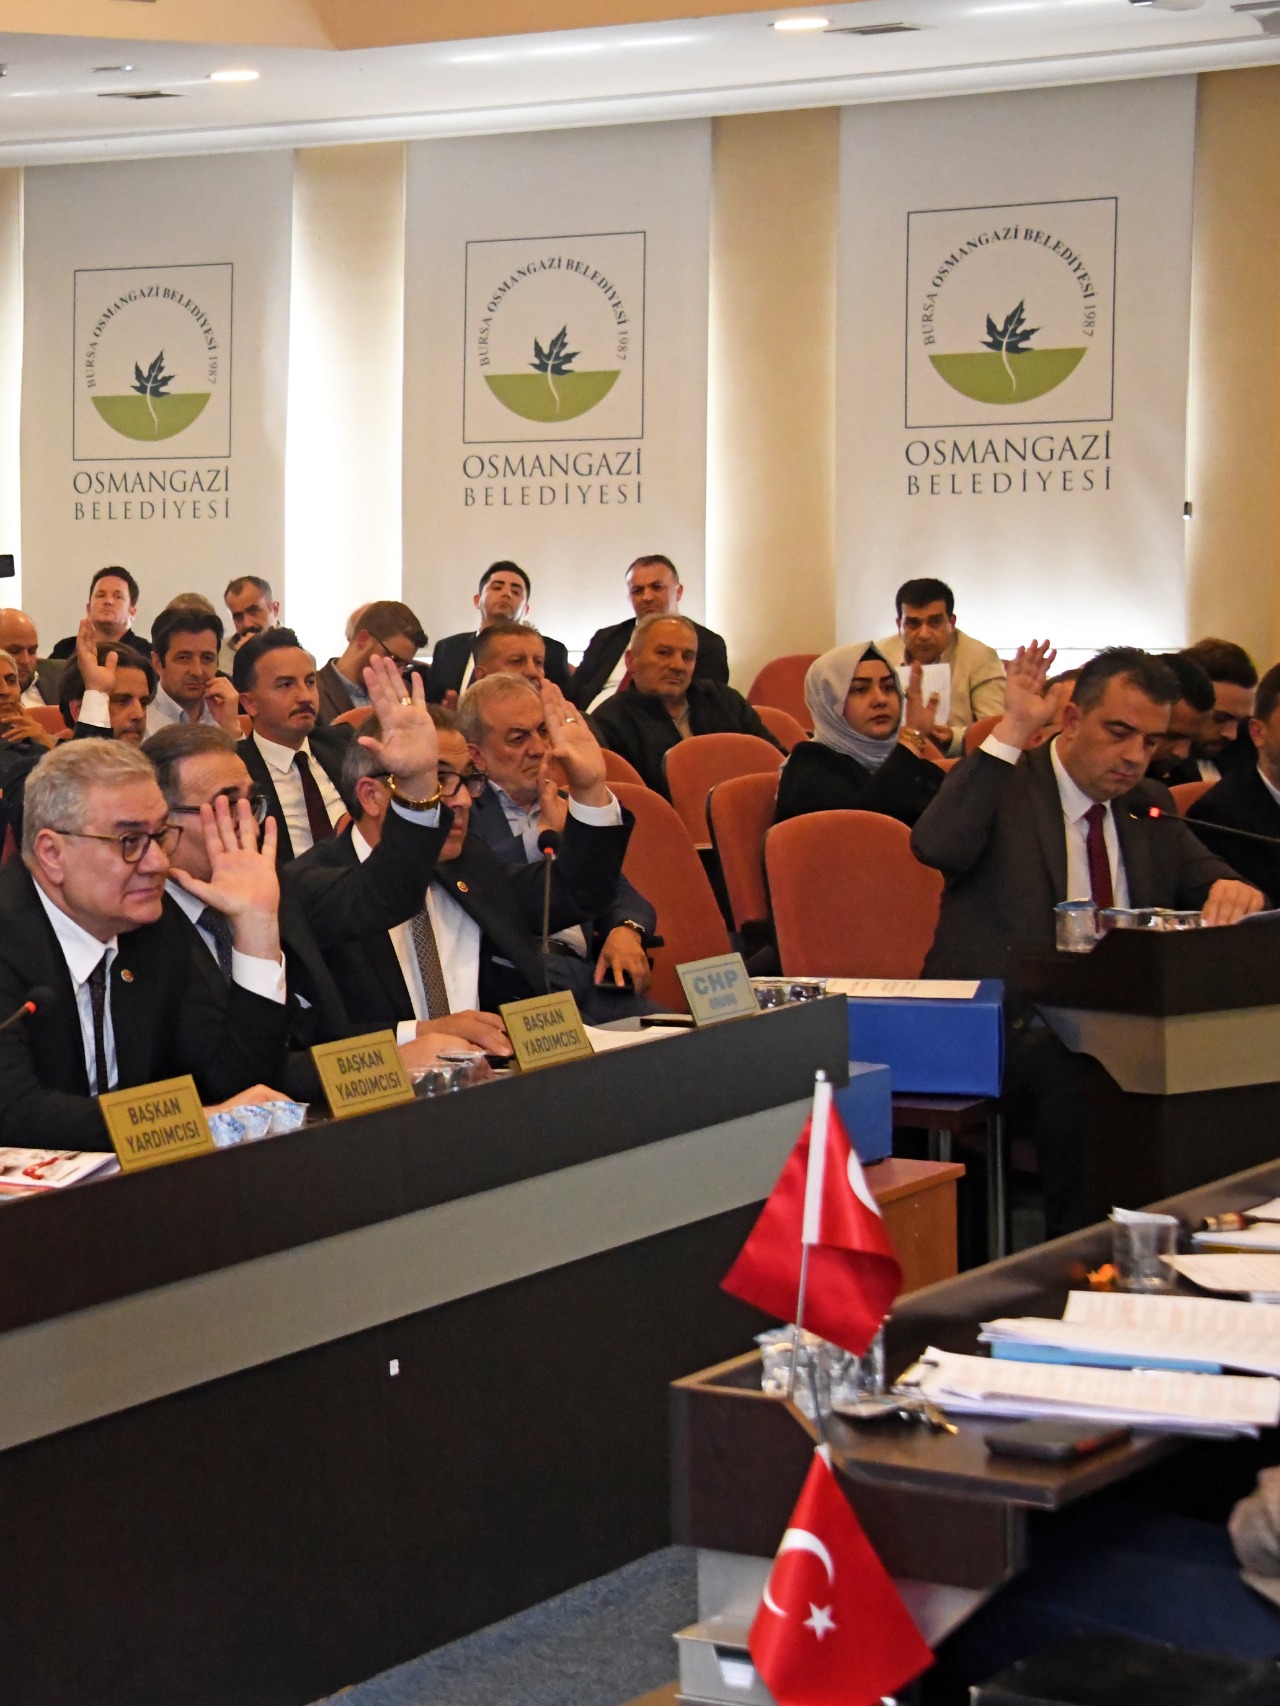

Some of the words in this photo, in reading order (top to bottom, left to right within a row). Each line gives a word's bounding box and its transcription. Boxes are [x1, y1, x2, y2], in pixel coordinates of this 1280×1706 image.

[922, 292, 938, 346] BURSA
[932, 224, 1020, 289] OSMANGAZİ
[1022, 227, 1098, 300] BELEDİYESİ
[1082, 304, 1096, 338] 1987
[480, 316, 493, 367] BURSA
[487, 255, 562, 313] OSMANGAZİ
[565, 258, 629, 326] BELEDİYESİ
[616, 330, 628, 361] 1987
[85, 341, 99, 389] BURSA
[93, 284, 160, 338] OSMANGAZİ
[208, 355, 219, 385] 1987
[905, 429, 1111, 466] OSMANGAZİ
[463, 448, 641, 479] OSMANGAZİ
[73, 465, 229, 494] OSMANGAZİ
[463, 481, 641, 507] BELEDİYESİ
[907, 466, 1111, 496] BELEDİYESİ
[74, 498, 230, 520] BELEDİYESİ
[693, 969, 738, 995] CHP
[522, 1008, 565, 1032] BAŞKAN
[522, 1028, 581, 1056] YARDIMCISI
[336, 1049, 385, 1074] BAŞKAN
[335, 1071, 402, 1101] YARDIMCISI
[128, 1097, 182, 1125] BAŞKAN
[125, 1119, 200, 1154] YARDIMCISI
